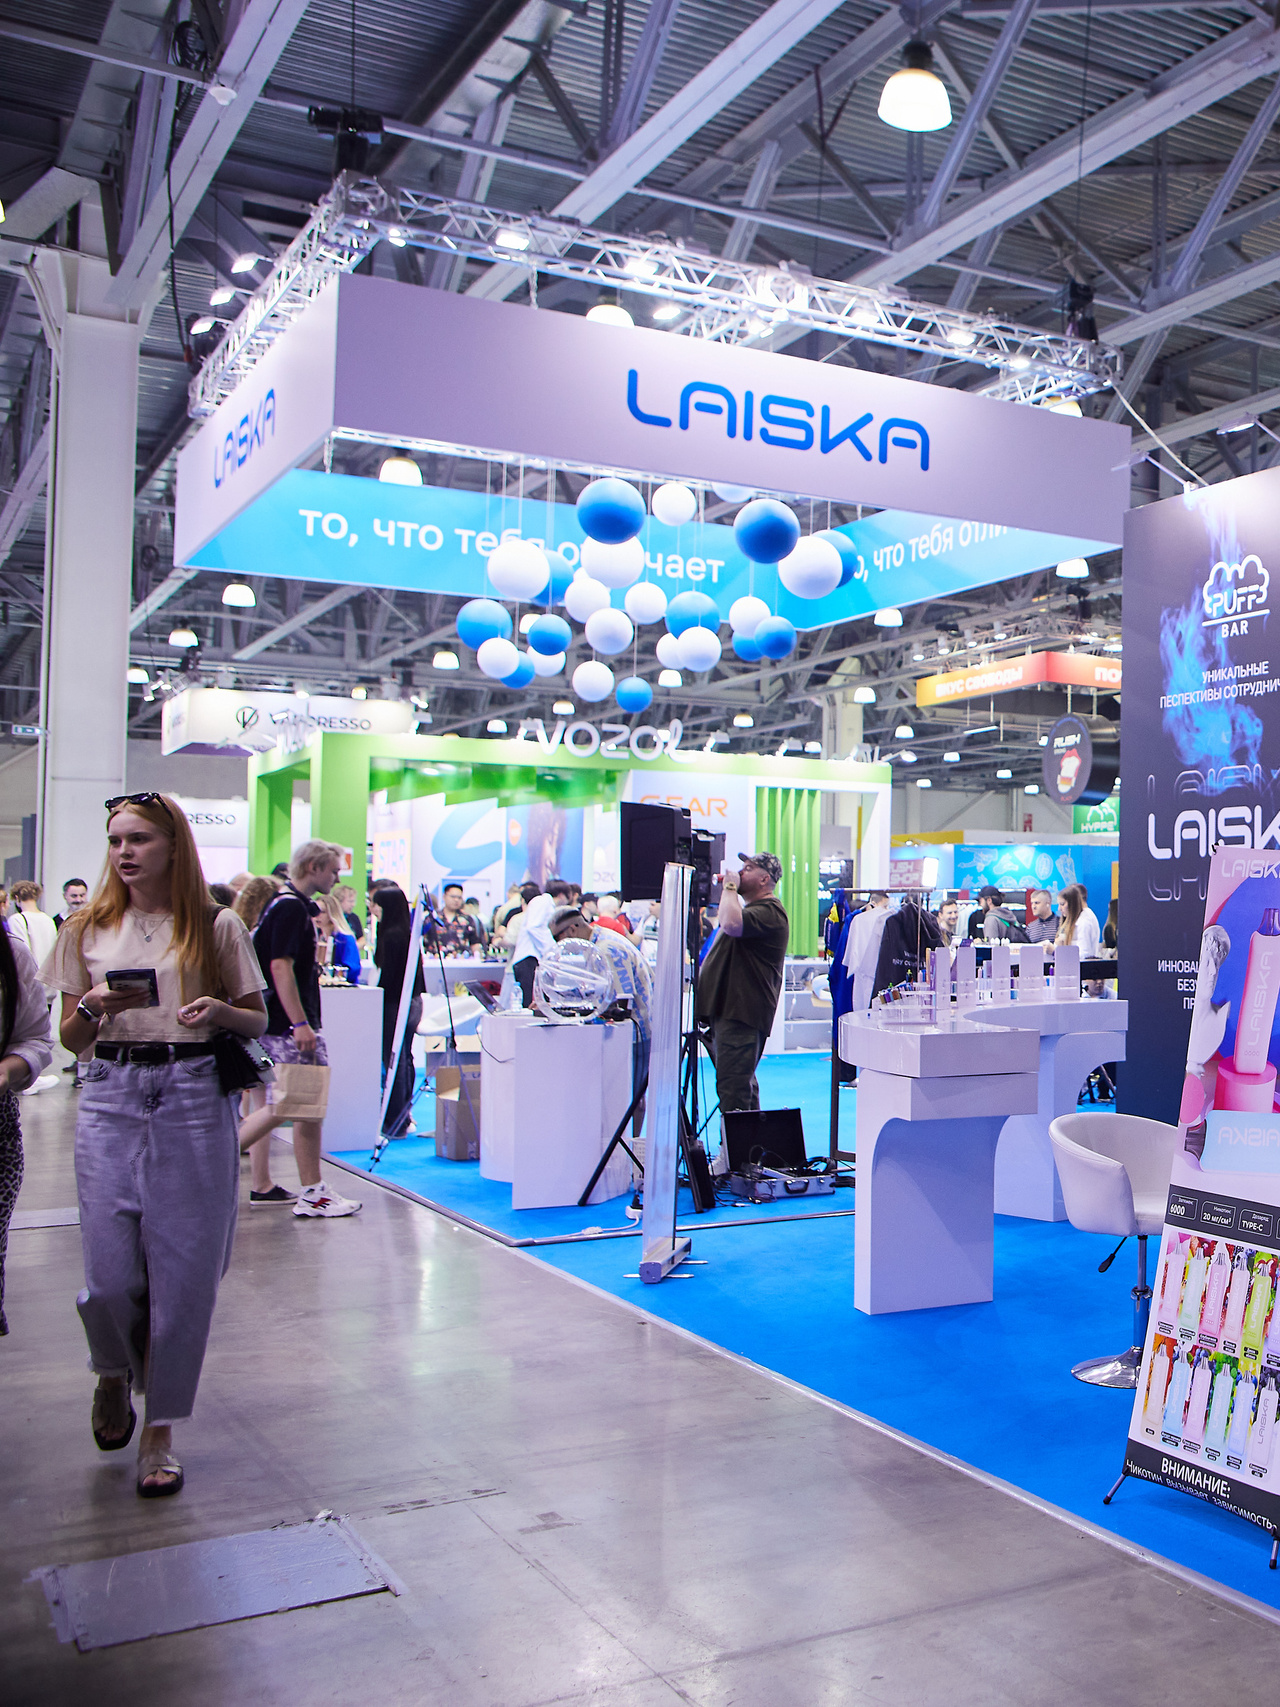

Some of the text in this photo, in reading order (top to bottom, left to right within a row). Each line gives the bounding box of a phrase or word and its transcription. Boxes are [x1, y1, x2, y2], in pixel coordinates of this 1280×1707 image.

[627, 369, 930, 471] LAISKA
[214, 388, 276, 488] LAISKA
[873, 542, 904, 572] что
[908, 523, 953, 562] тебя
[1213, 585, 1260, 616] PUFF
[1221, 620, 1249, 638] BAR
[1202, 661, 1269, 684] УНИКАЛЬНЫЕ
[1160, 687, 1222, 709] ПЕСПЕКТИВЫ
[1177, 979, 1197, 992] БЕЗ
[1170, 1204, 1185, 1216] 6000
[1203, 1212, 1211, 1221] 20
[1242, 1220, 1263, 1232] TYPE-C
[1161, 1457, 1231, 1498] ВНИМАНИЕ:
